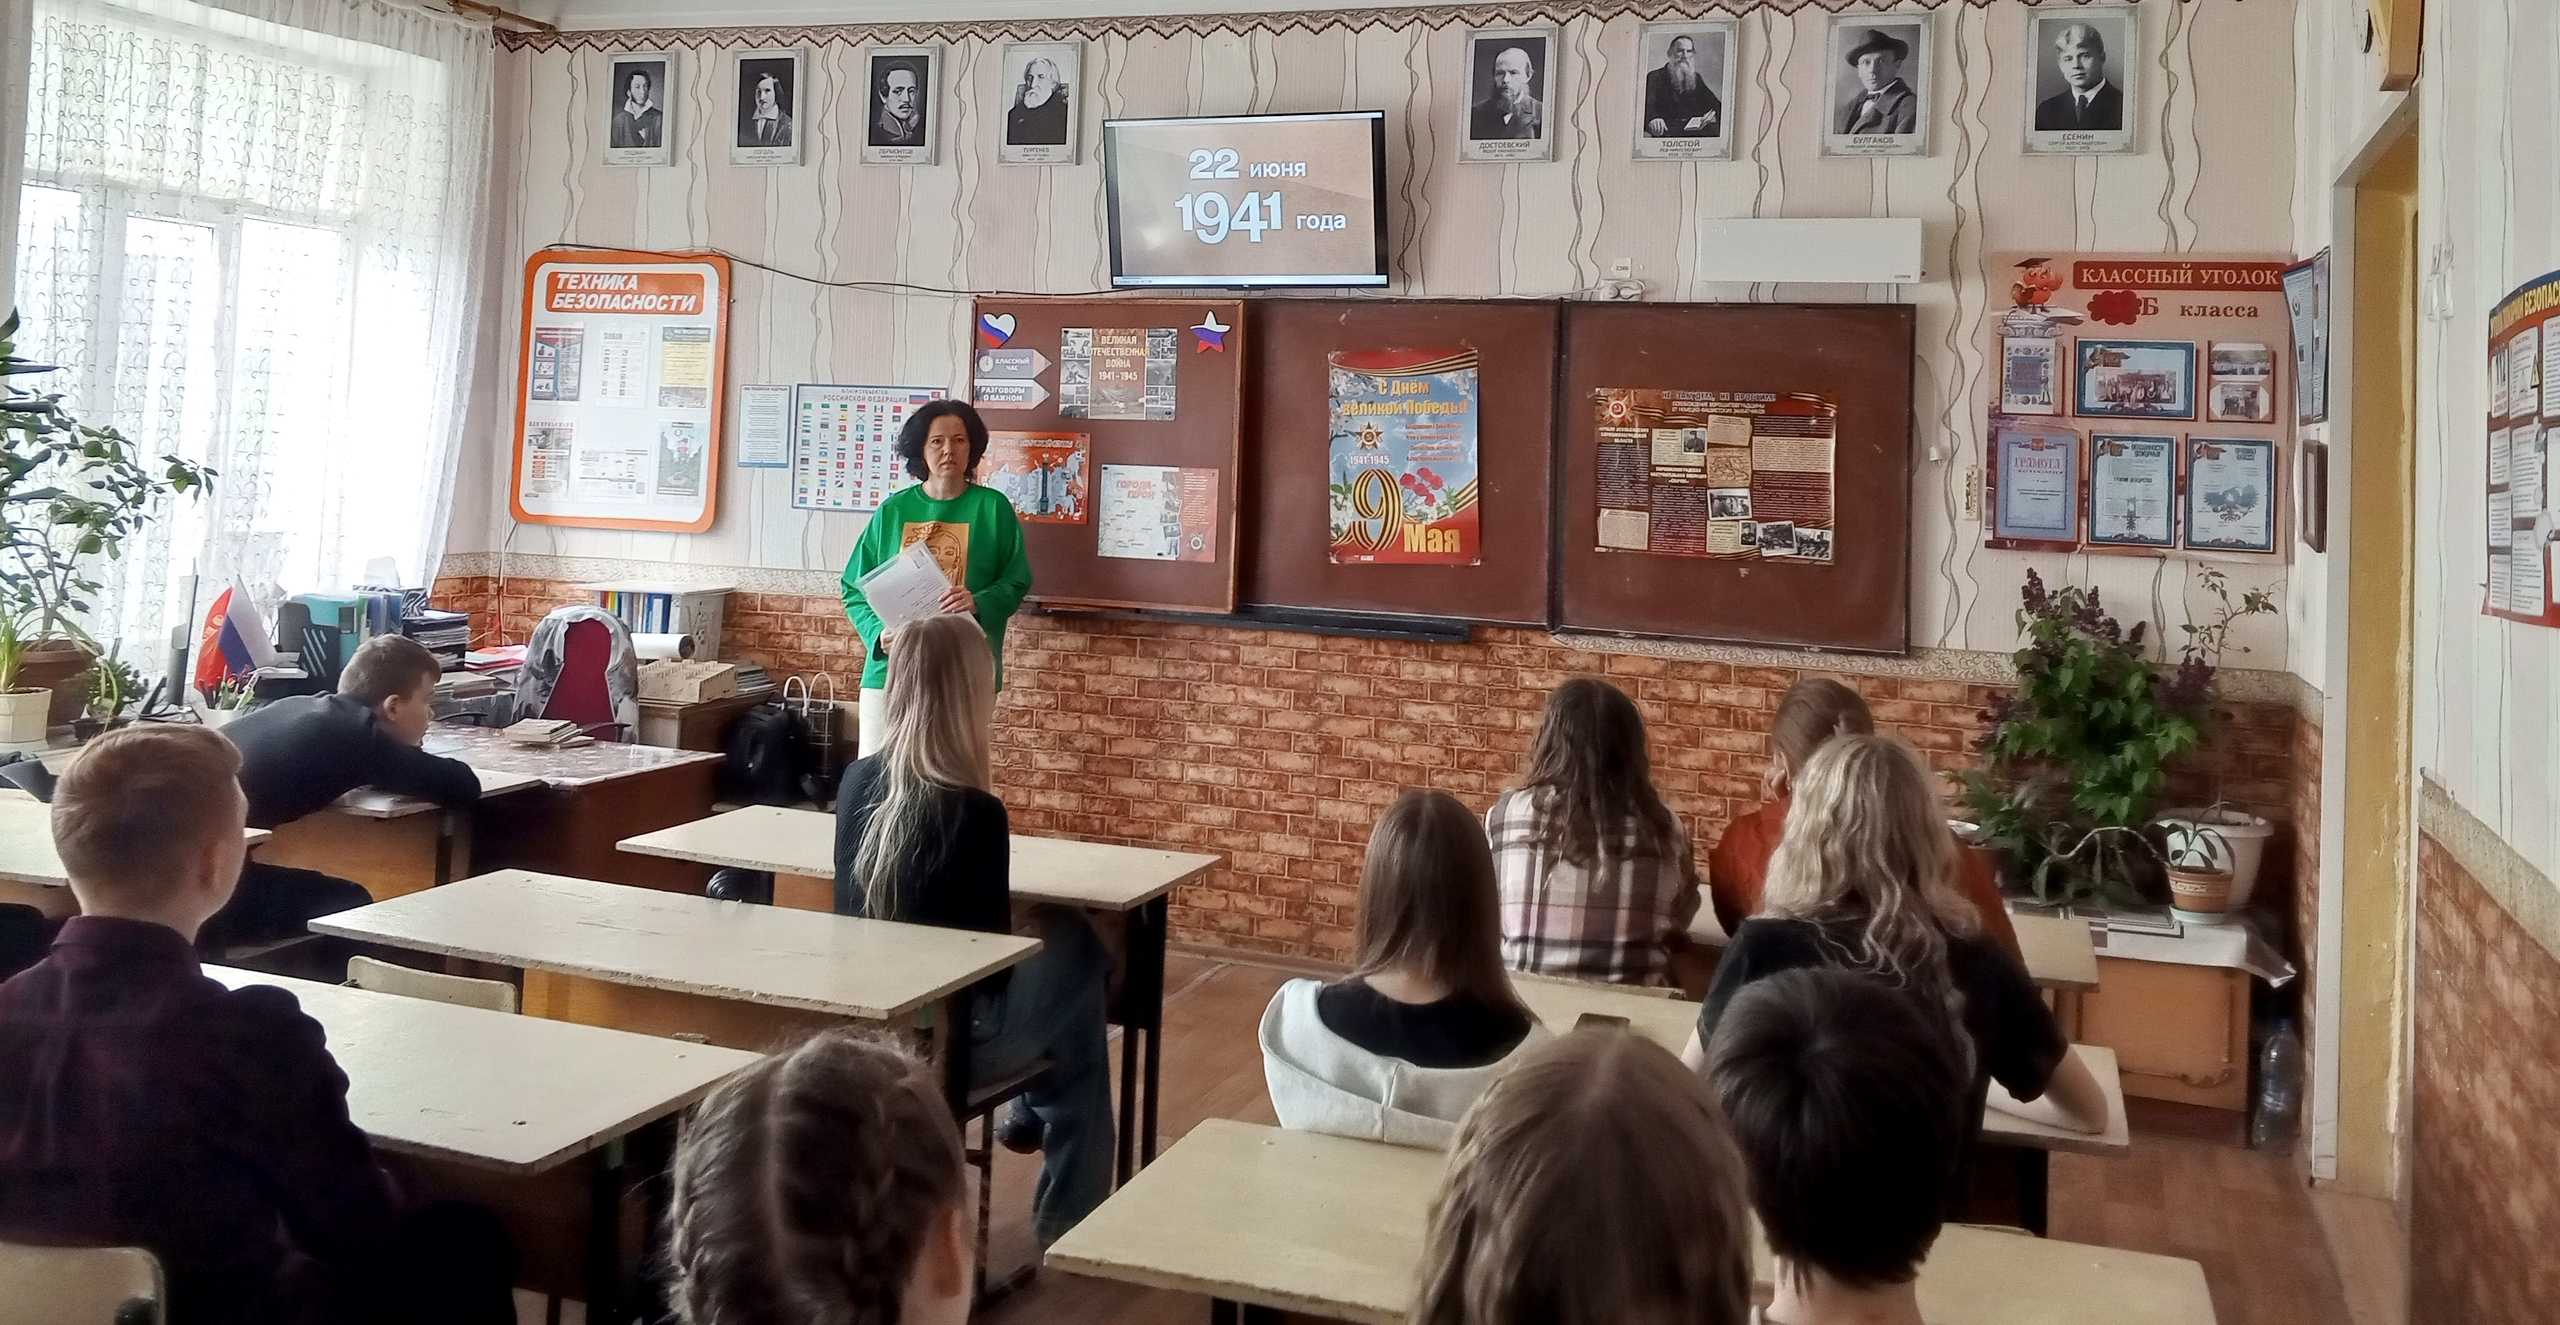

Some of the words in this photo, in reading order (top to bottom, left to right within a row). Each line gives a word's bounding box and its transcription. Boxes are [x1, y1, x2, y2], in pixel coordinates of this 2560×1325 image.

[1479, 141, 1531, 149] ДОСТОЕВСКИЙ
[1853, 136, 1895, 144] БУЛГАКОВ
[1188, 148, 1240, 180] 22
[1249, 161, 1307, 178] июня
[1174, 190, 1283, 245] 1941
[1295, 212, 1347, 232] года
[556, 273, 639, 291] ТЕХНИКА
[2081, 263, 2194, 285] КЛАССНЫЙ
[2199, 269, 2280, 286] УГОЛОК
[551, 292, 698, 312] БЕЗОПАСНОСТИ
[2524, 279, 2560, 318] БЕЗОПАС
[2140, 297, 2159, 316] Б
[2179, 303, 2260, 318] класса
[1101, 335, 1138, 345] ВЕЛИКАЯ
[1088, 347, 1150, 357] ОТЕЧЕСТВЕННАЯ
[995, 357, 1031, 365] КЛАССНЫЙ
[1105, 358, 1132, 368] ВОЙНА
[981, 386, 1026, 394] РАЗГОВОРЫ
[1378, 381, 1388, 395] С
[1391, 380, 1430, 395] Днём
[823, 394, 866, 402] РОССИЙСКОЙ
[867, 395, 907, 403] ФЕДЕРАЦИИ
[1342, 400, 1403, 415] великой
[1405, 400, 1468, 416] Победы!
[2014, 457, 2061, 469] ГРАМОТА
[1352, 468, 1402, 550] 9
[1404, 523, 1461, 552] Мая
